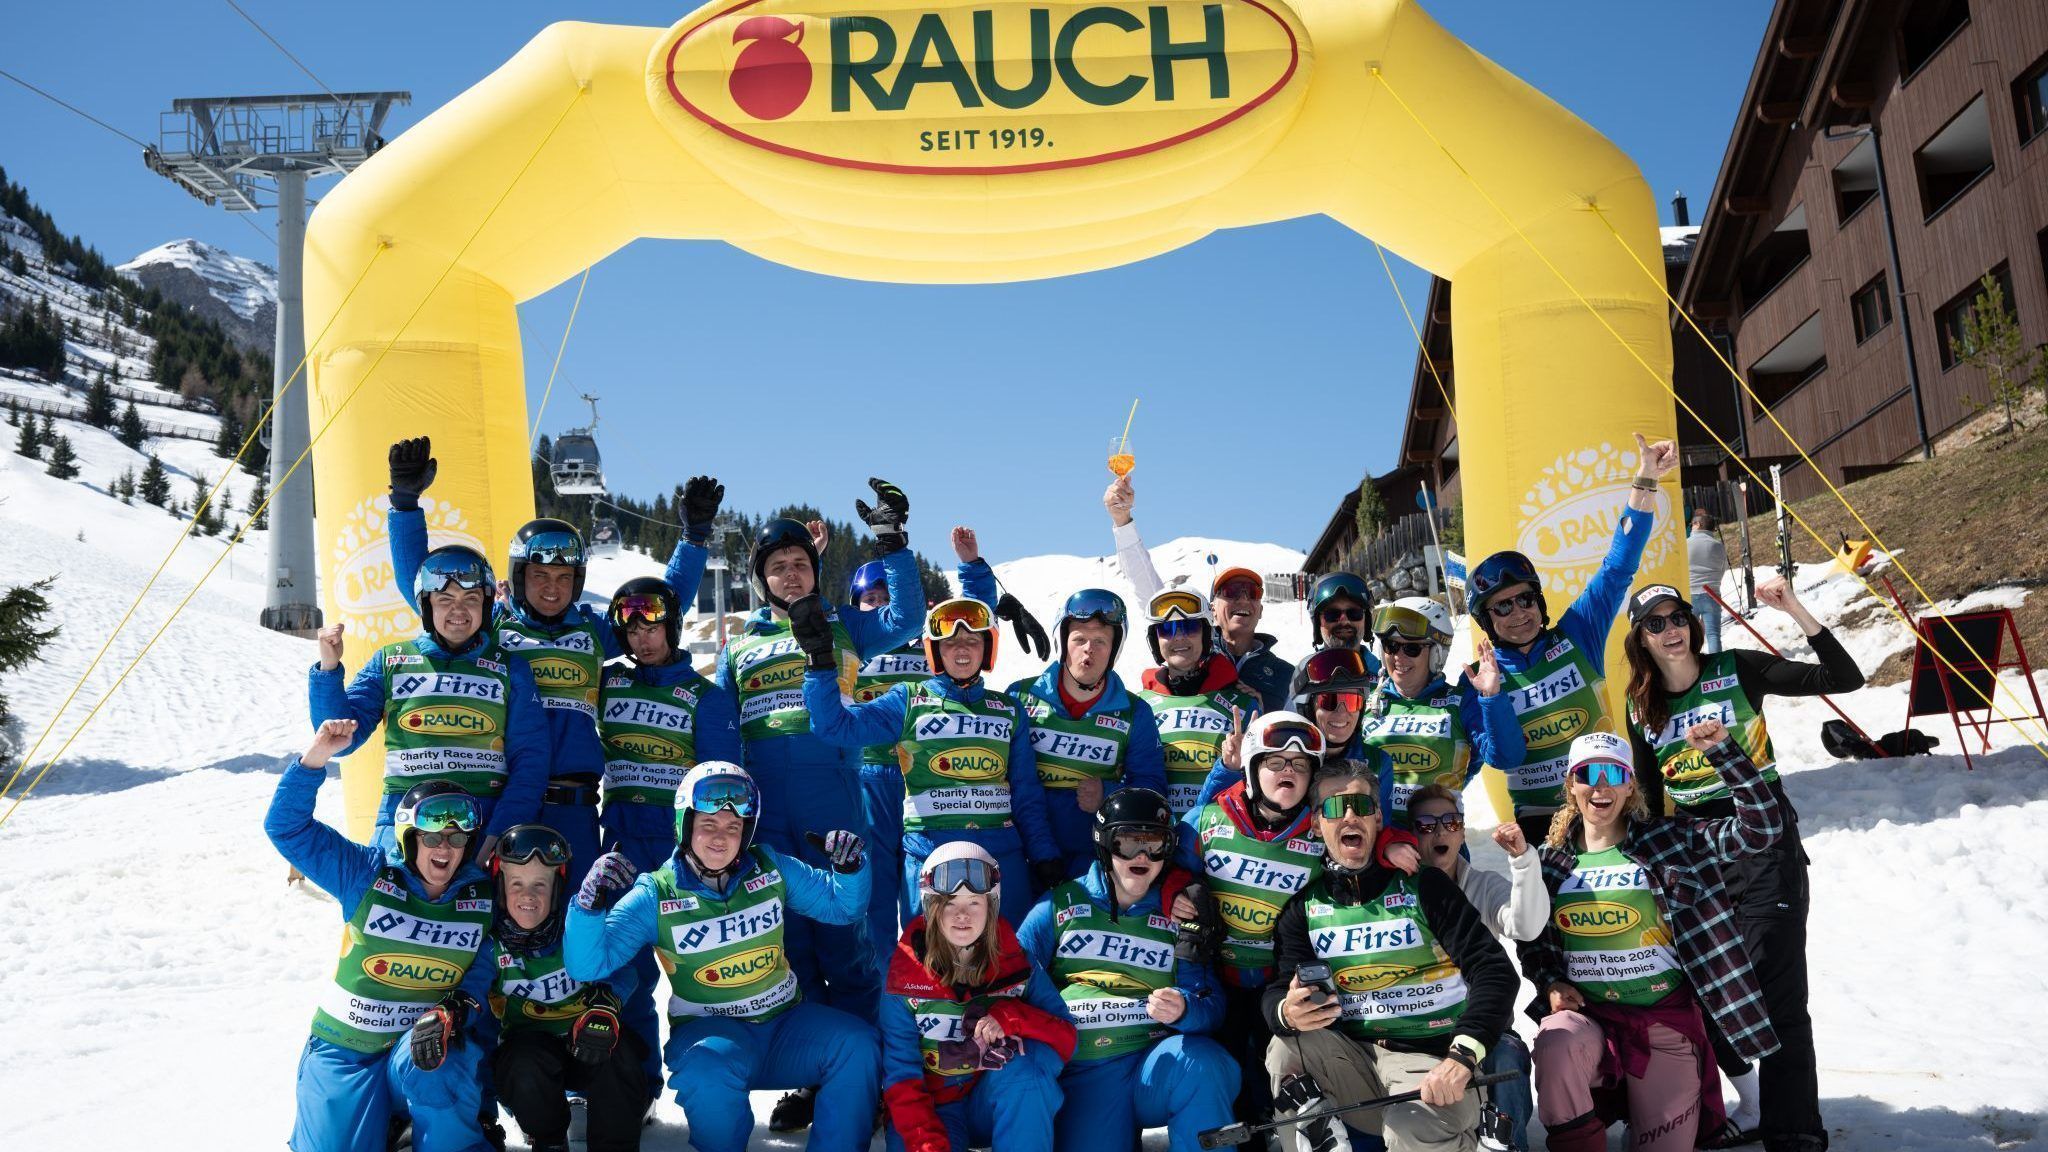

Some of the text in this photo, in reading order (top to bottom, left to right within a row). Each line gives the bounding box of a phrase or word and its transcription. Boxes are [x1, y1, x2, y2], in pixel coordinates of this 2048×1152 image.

[831, 4, 1230, 112] RAUCH
[919, 128, 1054, 151] SEIT 1919.
[1804, 580, 1827, 592] HEAD
[396, 646, 402, 654] 9
[496, 653, 502, 662] 9
[1546, 645, 1562, 660] BTV
[478, 660, 499, 670] BTV
[877, 656, 930, 673] First
[533, 667, 581, 682] RAUCH
[761, 667, 804, 686] RAUC
[431, 674, 502, 700] First
[1521, 668, 1580, 711] First
[1702, 680, 1722, 692] BTV
[674, 688, 691, 701] BTV
[547, 699, 572, 708] Race
[986, 700, 1005, 709] BTV
[630, 701, 690, 730] First
[741, 706, 776, 719] Special
[424, 714, 485, 731] RAUCH
[955, 716, 1010, 739] First
[1097, 716, 1118, 728] BTV
[1173, 710, 1231, 732] First
[1388, 716, 1449, 736] First
[1527, 713, 1582, 742] RAUCH
[623, 740, 675, 758] RAUCH
[1047, 733, 1115, 762] First
[401, 749, 505, 763] Charity Race 2026
[1169, 751, 1217, 764] RAUCH
[1391, 752, 1431, 767] AUCH
[405, 762, 445, 773] Special
[641, 765, 667, 775] Race
[668, 766, 690, 777] 202
[952, 757, 999, 772] RAUCH
[1517, 765, 1553, 777] Charity
[1676, 755, 1712, 773] RAUC
[642, 775, 682, 788] Olympi
[1521, 773, 1559, 786] Special
[929, 789, 968, 801] Charity
[971, 788, 994, 798] Race
[1394, 786, 1413, 796] Rac
[932, 799, 1010, 812] Special Olympics
[1211, 814, 1217, 825] 6
[1288, 840, 1310, 855] BTV
[388, 868, 395, 880] 5
[1232, 857, 1307, 892] First
[1573, 866, 1646, 890] First
[375, 880, 394, 893] BTV
[747, 875, 767, 892] BTV
[470, 885, 477, 898] 5
[1066, 892, 1072, 904] 1
[457, 901, 478, 911] BTV
[661, 901, 682, 913] BTV
[1385, 894, 1405, 907] BTV
[1222, 901, 1280, 927] RAUCH
[1569, 910, 1629, 928] RAUCH
[718, 903, 783, 944] First
[1149, 916, 1170, 929] BTV
[407, 919, 482, 954] First
[1343, 922, 1417, 952] First
[1097, 934, 1172, 969] First
[721, 951, 774, 979] RAUCH
[1600, 955, 1627, 966] Race
[389, 962, 458, 985] RAUCH
[1571, 961, 1656, 977] Special Olympics
[1371, 989, 1404, 1001] Race
[1407, 985, 1445, 998] 2026
[351, 998, 429, 1016] Charity Race
[1102, 999, 1135, 1010] Race
[1376, 999, 1436, 1015] Olympics
[348, 1011, 396, 1028] Special
[588, 1021, 610, 1032] LEKI
